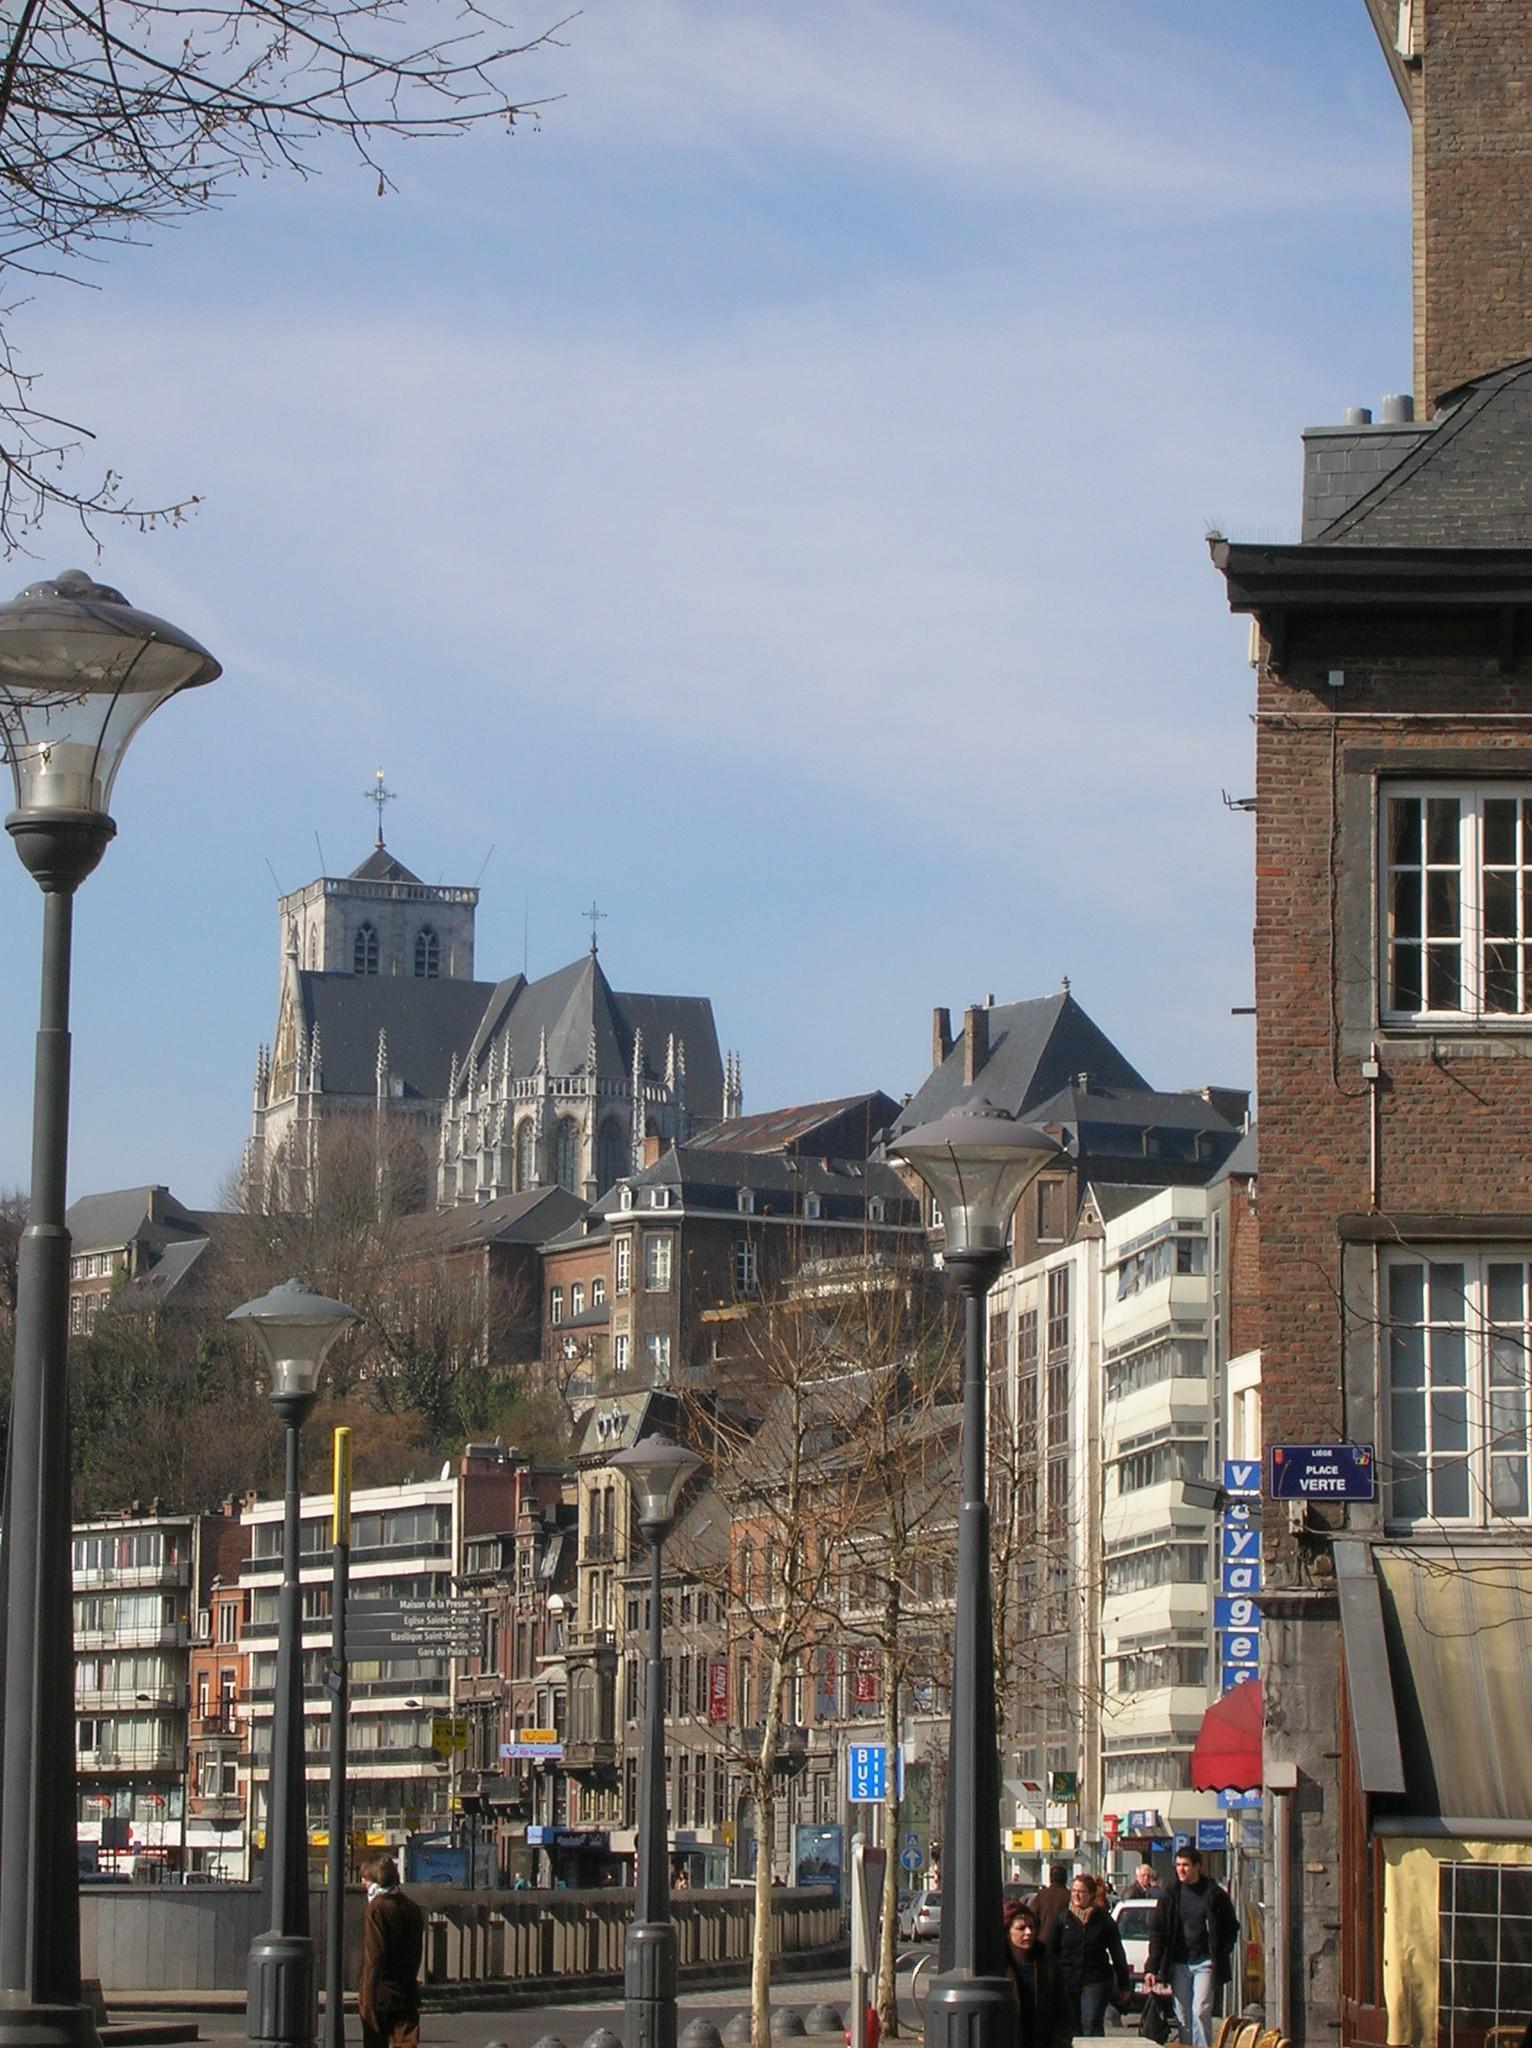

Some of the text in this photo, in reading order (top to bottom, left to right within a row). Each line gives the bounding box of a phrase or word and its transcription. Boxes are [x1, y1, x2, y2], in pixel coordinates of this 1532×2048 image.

[1306, 1465, 1339, 1475] PLACE
[1299, 1479, 1346, 1491] VERTE
[400, 1600, 469, 1609] Maison de la Presse
[426, 1616, 469, 1625] Sainte-Croix
[391, 1632, 469, 1643] Basilique Saint-Martin
[418, 1647, 468, 1656] Gare du Palais
[858, 1749, 868, 1797] BUS
